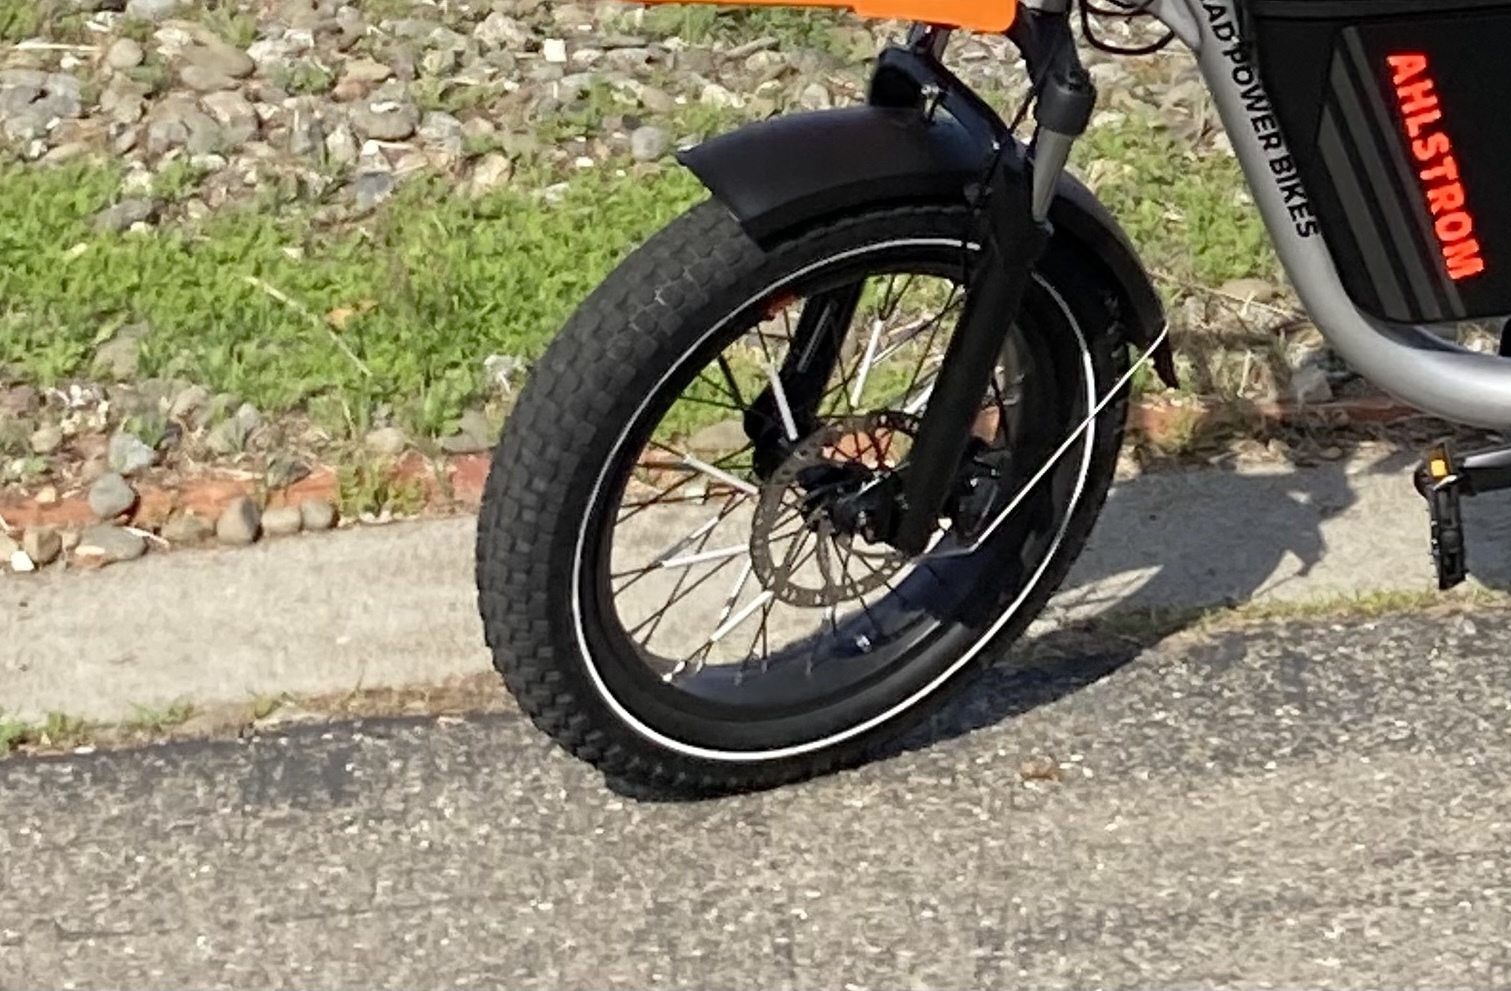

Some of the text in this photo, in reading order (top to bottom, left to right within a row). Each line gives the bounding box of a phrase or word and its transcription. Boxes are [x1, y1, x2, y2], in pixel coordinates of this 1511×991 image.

[1221, 45, 1283, 152] POWER
[1268, 154, 1320, 239] BIKES
[1386, 52, 1486, 282] AHLSTROM
